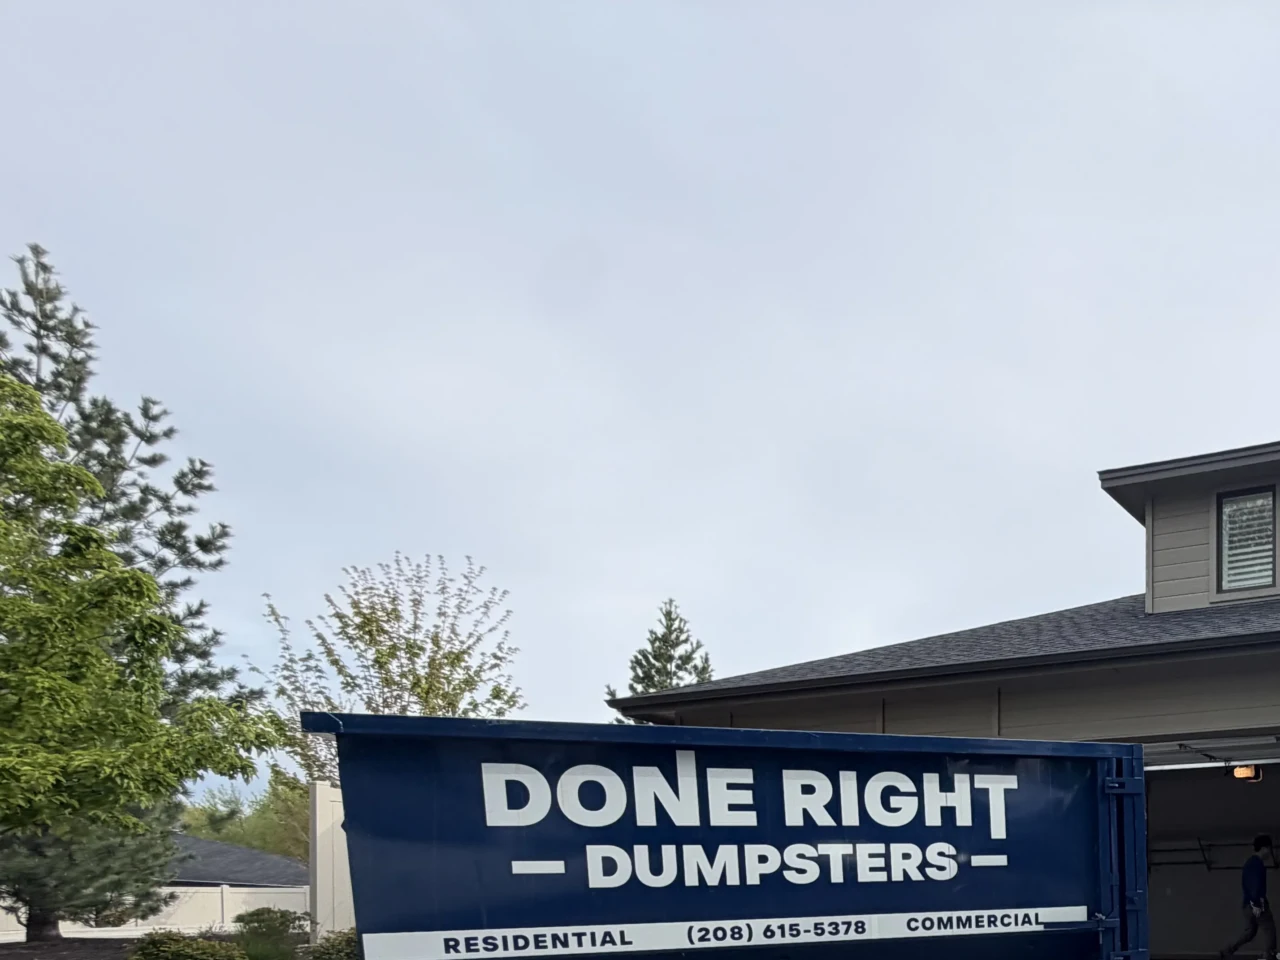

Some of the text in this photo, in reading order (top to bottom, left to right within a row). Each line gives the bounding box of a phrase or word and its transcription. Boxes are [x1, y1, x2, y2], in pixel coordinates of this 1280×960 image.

[481, 750, 1018, 839] DONE RIGHT
[585, 842, 959, 888] DUMPSTERS
[443, 912, 1044, 954] RESIDENTIAL (208) 615-5378 COMMERCIAL
